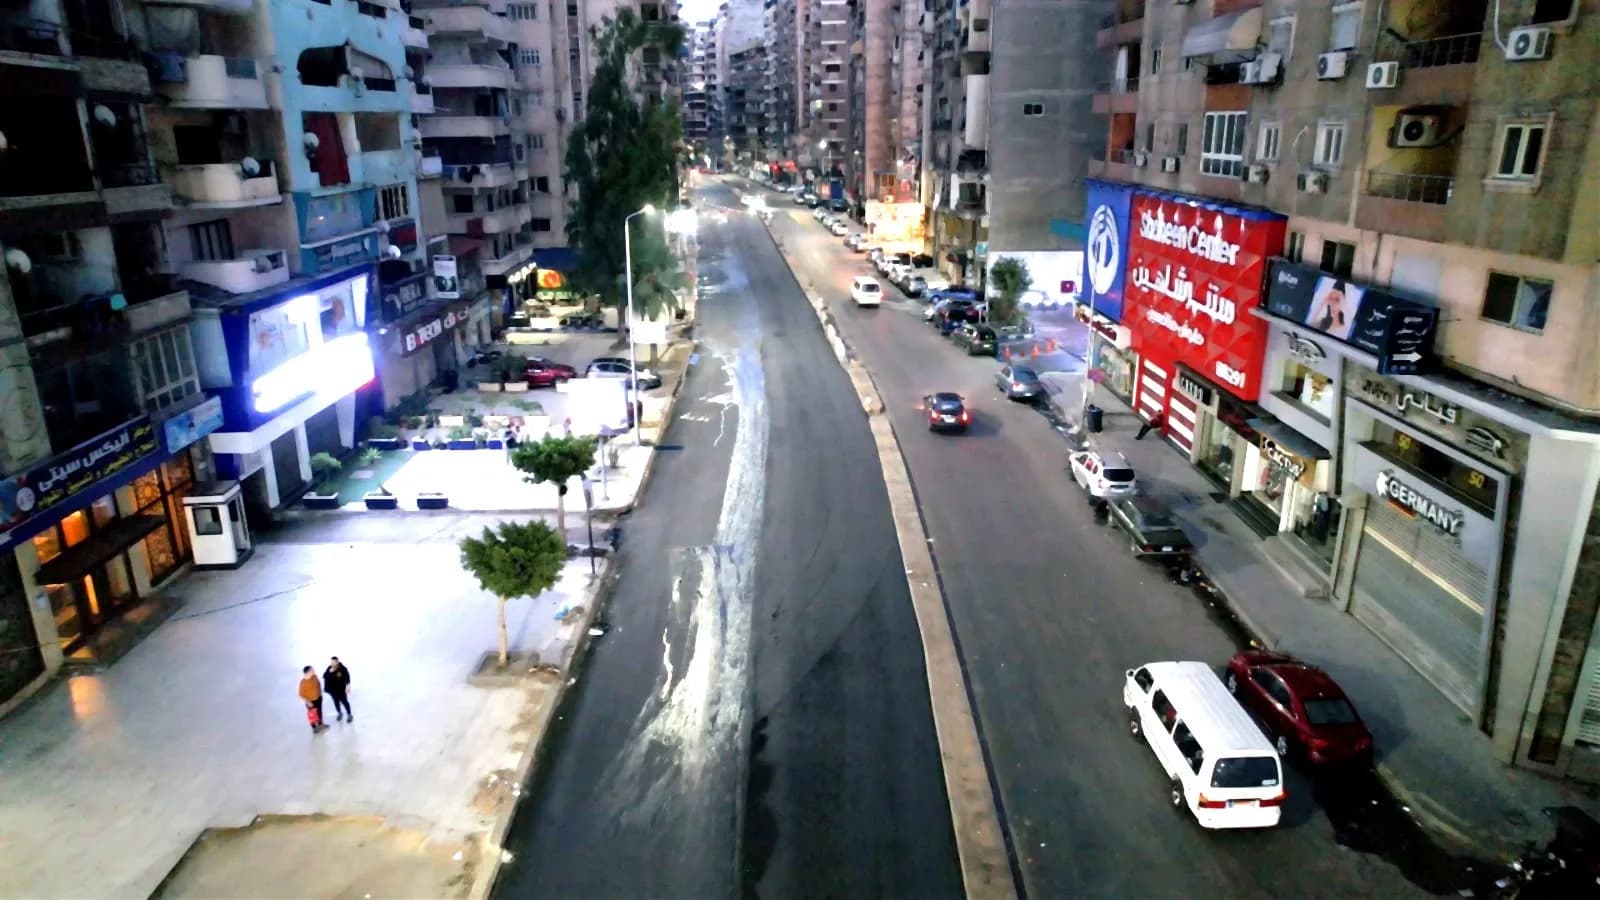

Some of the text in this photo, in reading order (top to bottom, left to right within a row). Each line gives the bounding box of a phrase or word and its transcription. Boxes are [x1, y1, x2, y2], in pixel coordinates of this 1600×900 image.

[1140, 207, 1240, 266] Shaheen Center
[1132, 258, 1236, 325] سنتر شاهين
[1388, 480, 1462, 534] GERMANY
